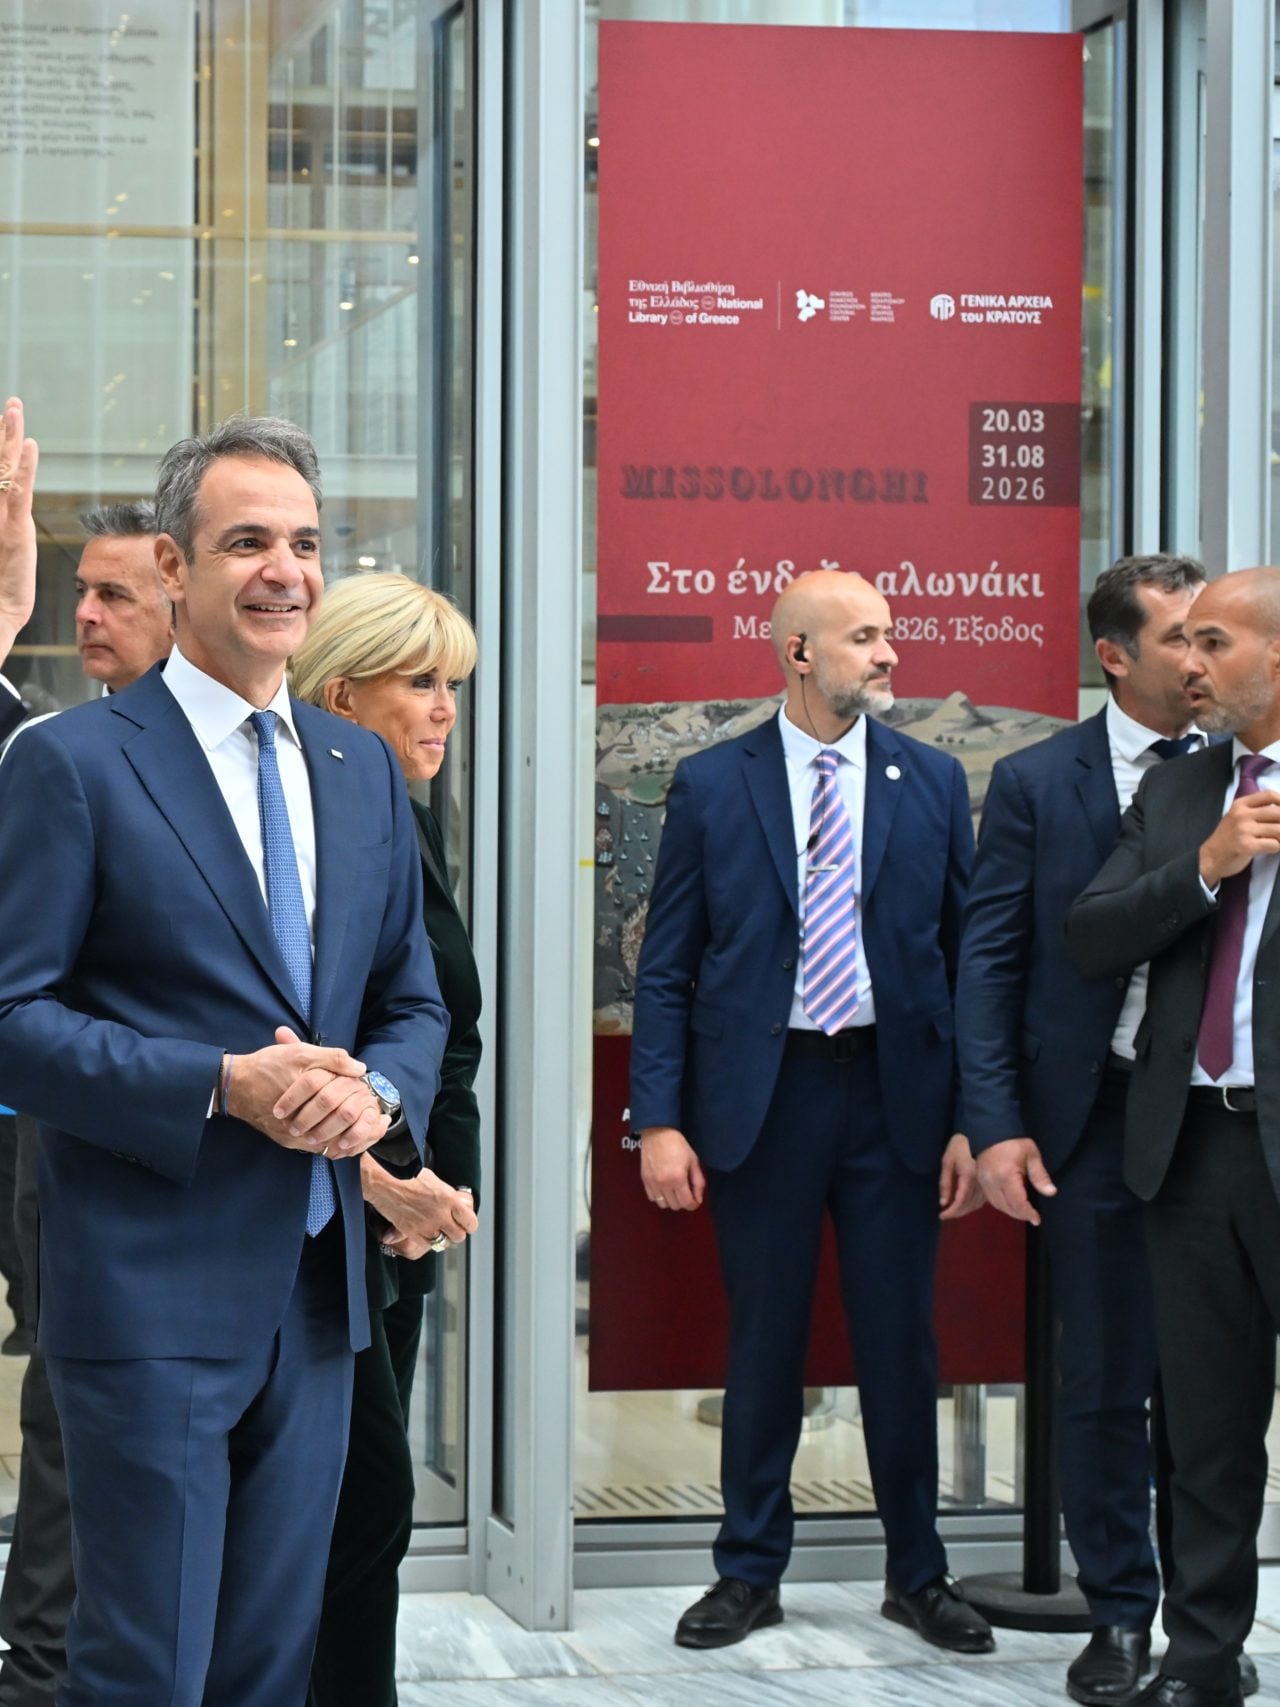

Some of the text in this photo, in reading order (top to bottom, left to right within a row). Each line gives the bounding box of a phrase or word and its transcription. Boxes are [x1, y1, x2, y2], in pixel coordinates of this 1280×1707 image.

[717, 298, 763, 309] National
[960, 295, 1053, 308] ΓΕΝΙΚΑ ΑΡΧΕΙΑ
[628, 311, 740, 325] Library of Greece
[960, 311, 1042, 324] του ΚΡΑΤΟΥΣ
[982, 409, 1045, 432] 20.03
[982, 444, 1045, 468] 31.08
[621, 463, 929, 504] MISSOLONGHI
[982, 476, 1045, 500] 2026
[646, 561, 716, 595] Στο
[875, 560, 1046, 597] αλωνάκι
[886, 615, 1044, 648] 826, Έξοδος
